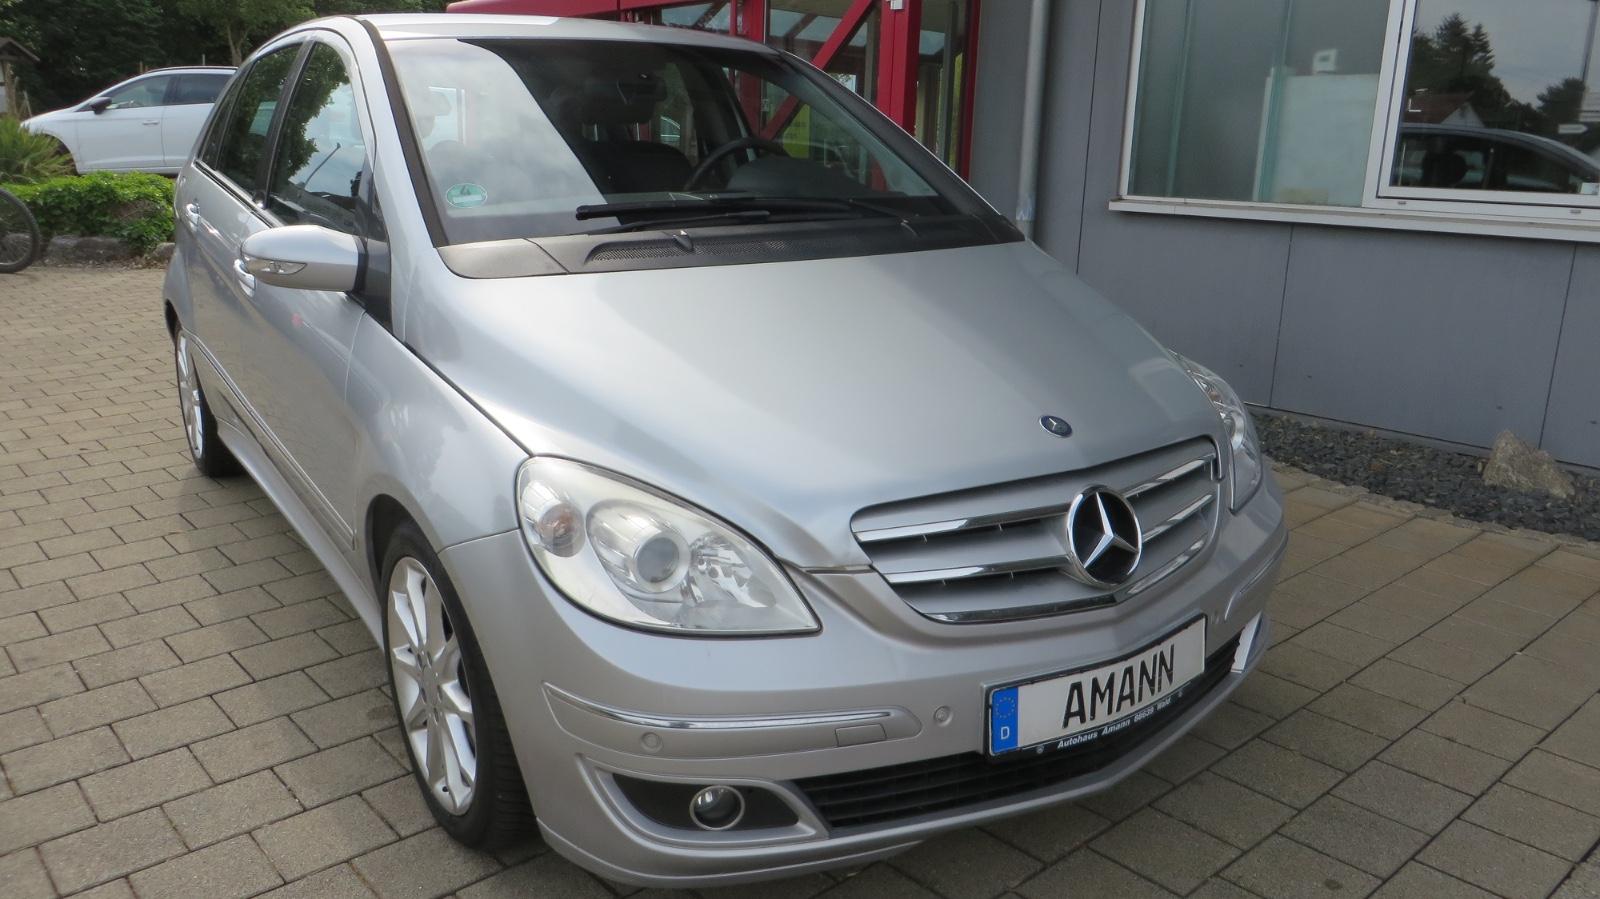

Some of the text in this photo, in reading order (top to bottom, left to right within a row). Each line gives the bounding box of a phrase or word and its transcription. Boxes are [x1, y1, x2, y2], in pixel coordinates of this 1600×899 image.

[1061, 643, 1175, 730] AMANN
[1000, 726, 1011, 740] D
[1057, 731, 1099, 749] Autohaus
[1102, 718, 1132, 736] Amann
